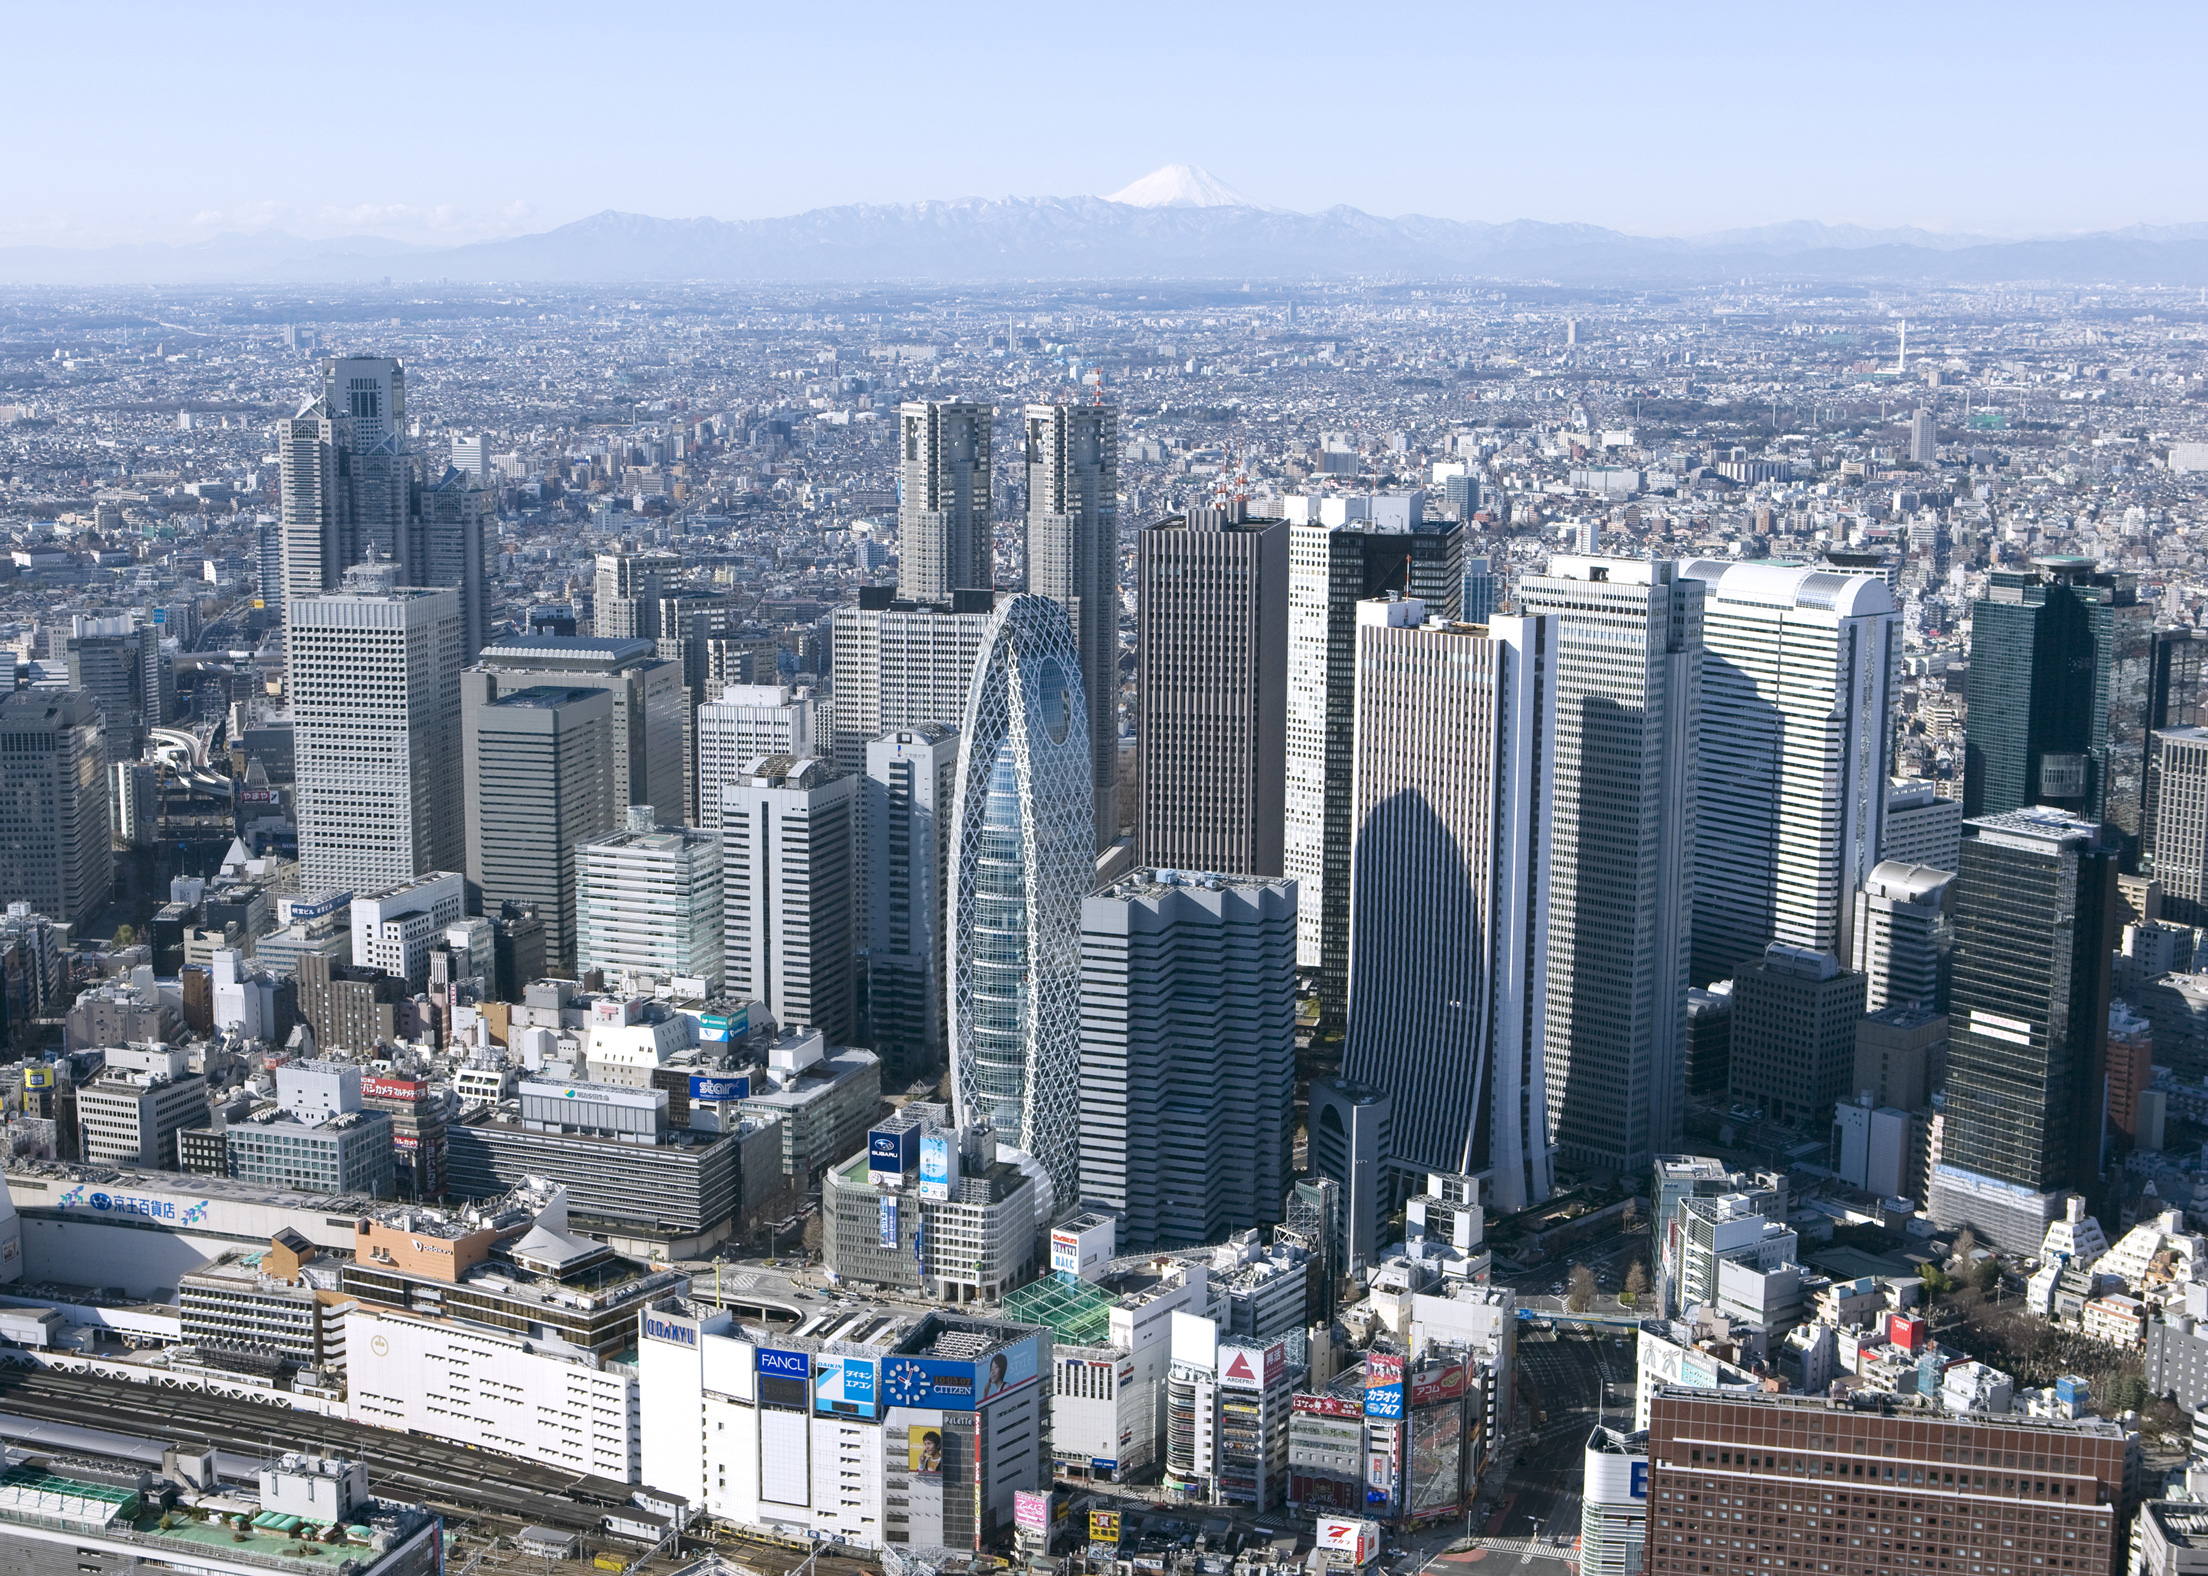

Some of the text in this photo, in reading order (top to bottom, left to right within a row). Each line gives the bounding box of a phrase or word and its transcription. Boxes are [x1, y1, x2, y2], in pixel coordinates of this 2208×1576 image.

[243, 791, 269, 800] やまや
[699, 1080, 733, 1095] star
[871, 1150, 898, 1158] SUBARU
[113, 1195, 175, 1219] 京王百貨店
[1055, 1256, 1075, 1270] HALC
[647, 1318, 695, 1345] ODAKYU
[762, 1354, 805, 1372] FANCL
[817, 1361, 843, 1370] DAIKIN
[845, 1369, 873, 1381] ダイキン
[845, 1379, 872, 1390] エアコン
[1226, 1377, 1255, 1386] ARDEPRO
[933, 1385, 972, 1395] CITIZEN
[1367, 1388, 1401, 1404] カラオケ
[1416, 1384, 1440, 1396] アコム
[1379, 1403, 1400, 1416] 747
[1327, 1525, 1352, 1538] 7
